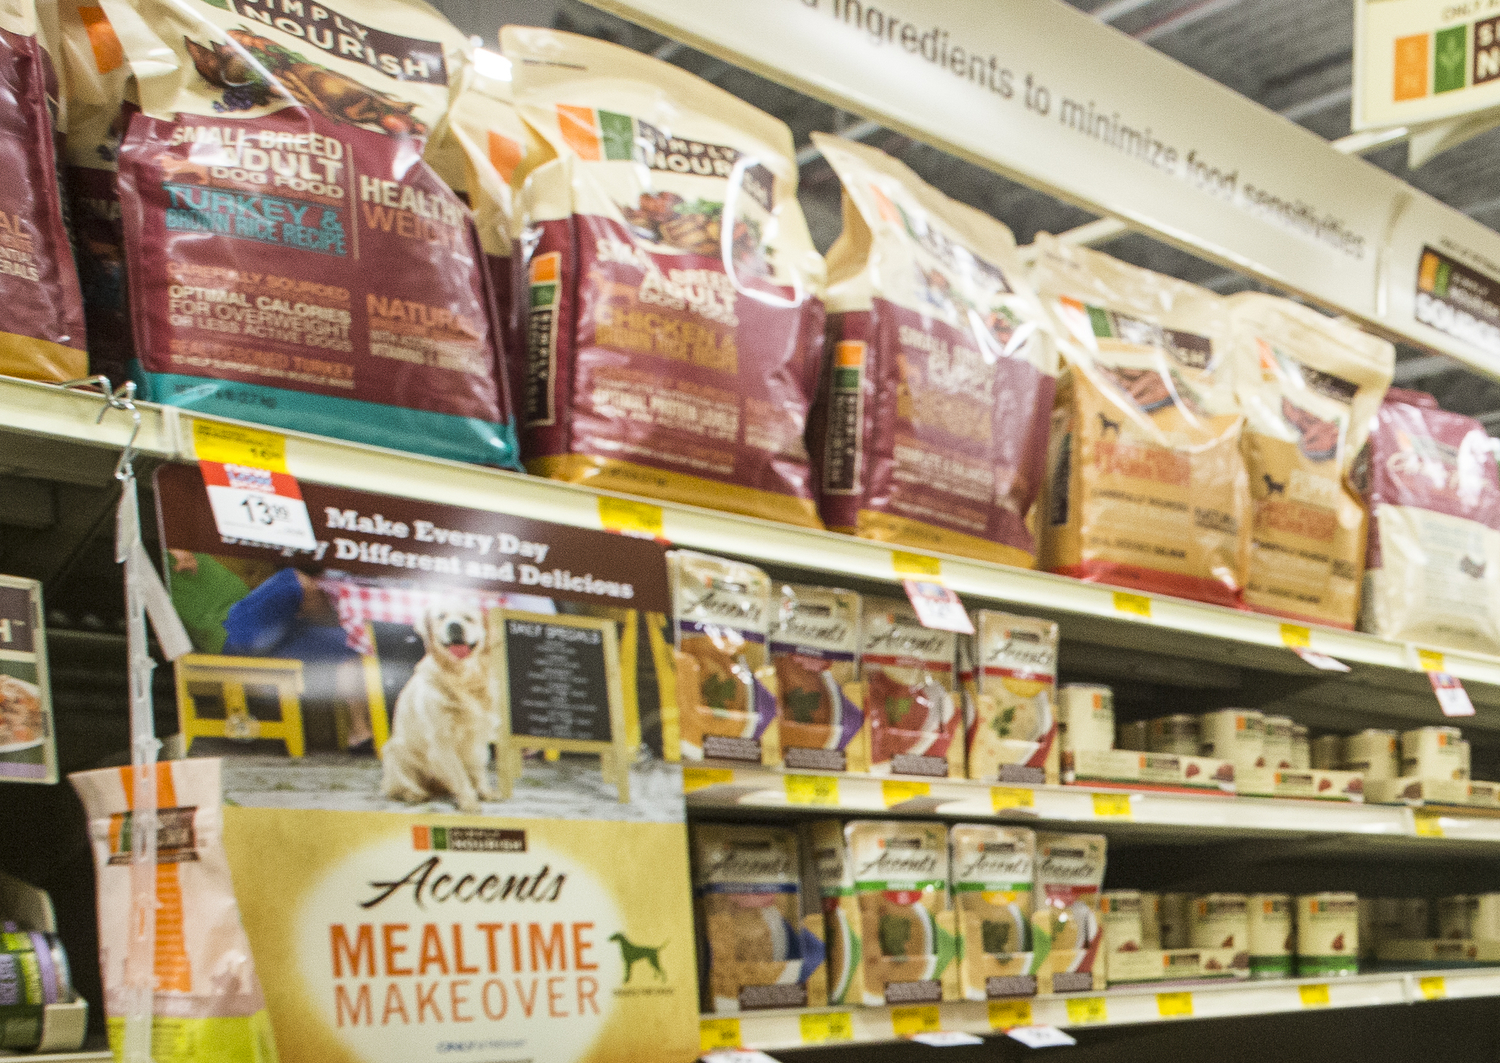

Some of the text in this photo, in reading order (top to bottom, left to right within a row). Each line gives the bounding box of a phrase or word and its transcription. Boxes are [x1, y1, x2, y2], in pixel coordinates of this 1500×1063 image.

[244, 5, 430, 79] NOURISH
[248, 0, 369, 41] IMPLY
[259, 130, 343, 161] BREED
[1025, 72, 1052, 116] to
[1059, 97, 1179, 175] minimize
[165, 185, 342, 232] TURKEY &
[211, 167, 345, 199] DOG FOOD
[169, 285, 253, 308] OPTIMAL
[325, 506, 550, 562] Make Every Day
[334, 537, 459, 575] Different
[463, 556, 515, 582] and
[519, 563, 635, 600] Delicious
[358, 855, 569, 910] Accents
[328, 921, 600, 980] MEALTIME
[333, 974, 602, 1030] MAKEOVER
